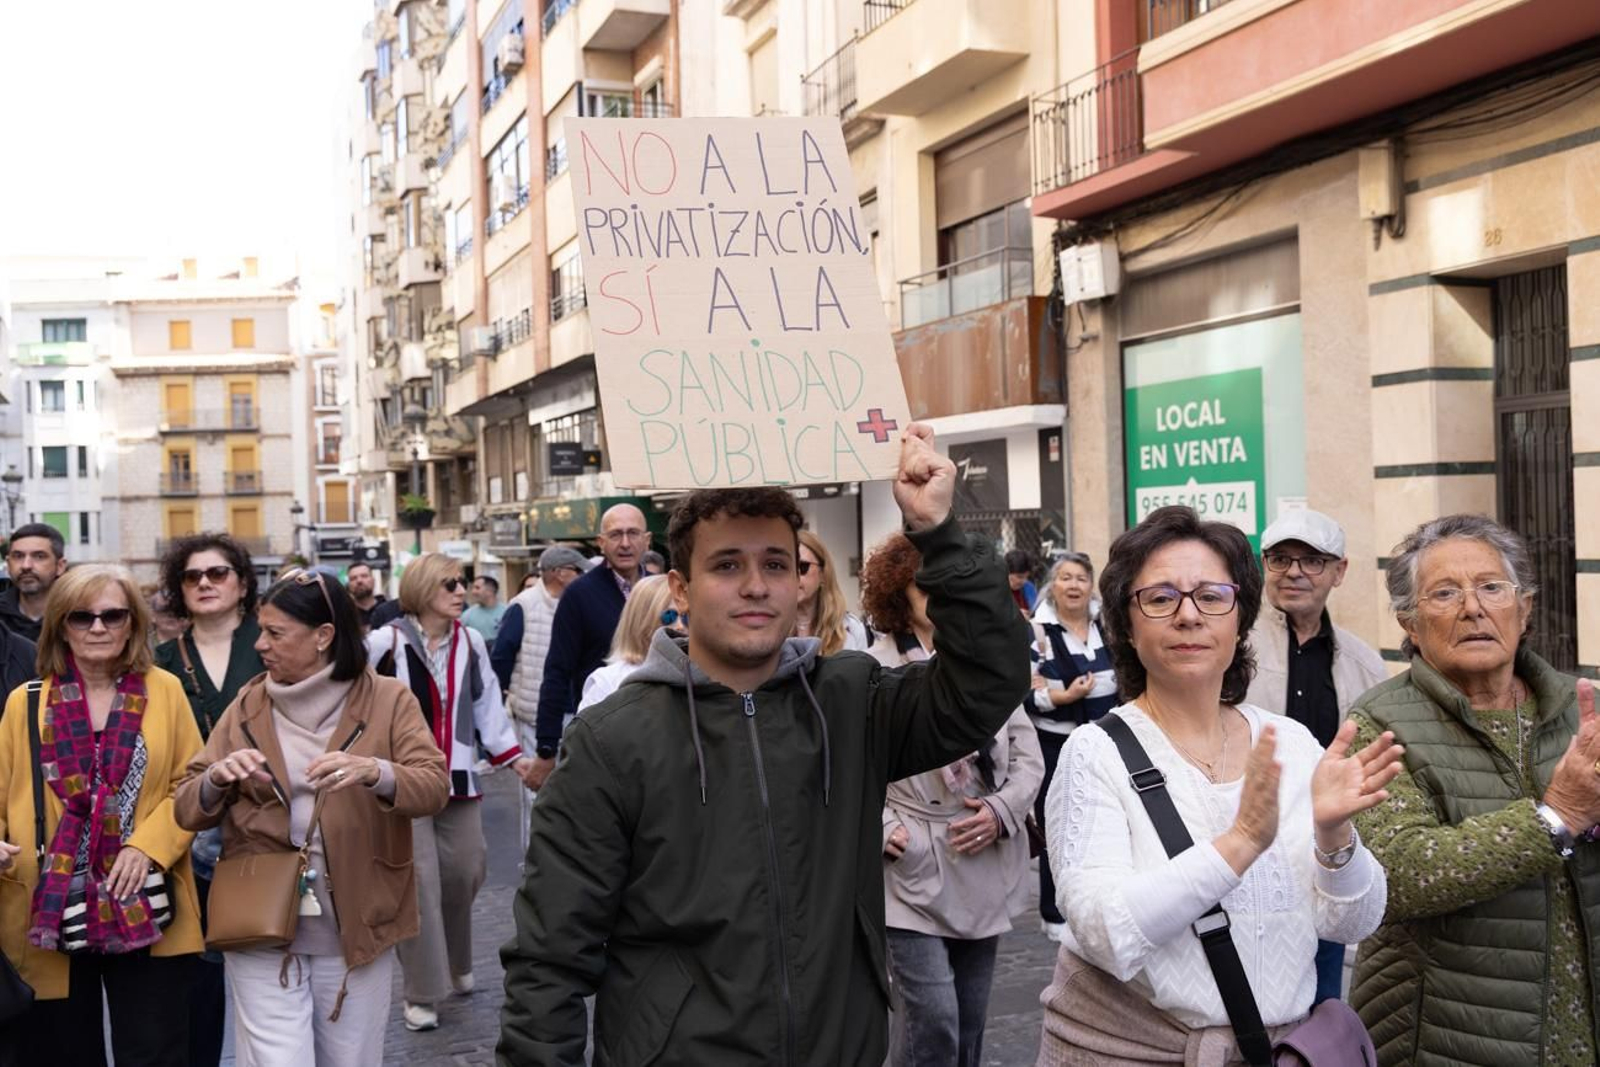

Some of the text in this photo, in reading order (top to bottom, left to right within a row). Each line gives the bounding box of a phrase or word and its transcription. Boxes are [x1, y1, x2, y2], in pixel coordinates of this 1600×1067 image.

[581, 130, 837, 196] NO A LA
[600, 264, 850, 335] SÍ A LA
[1156, 399, 1226, 432] LOCAL
[1140, 436, 1247, 470] EN VENTA
[1214, 491, 1247, 514] 074
